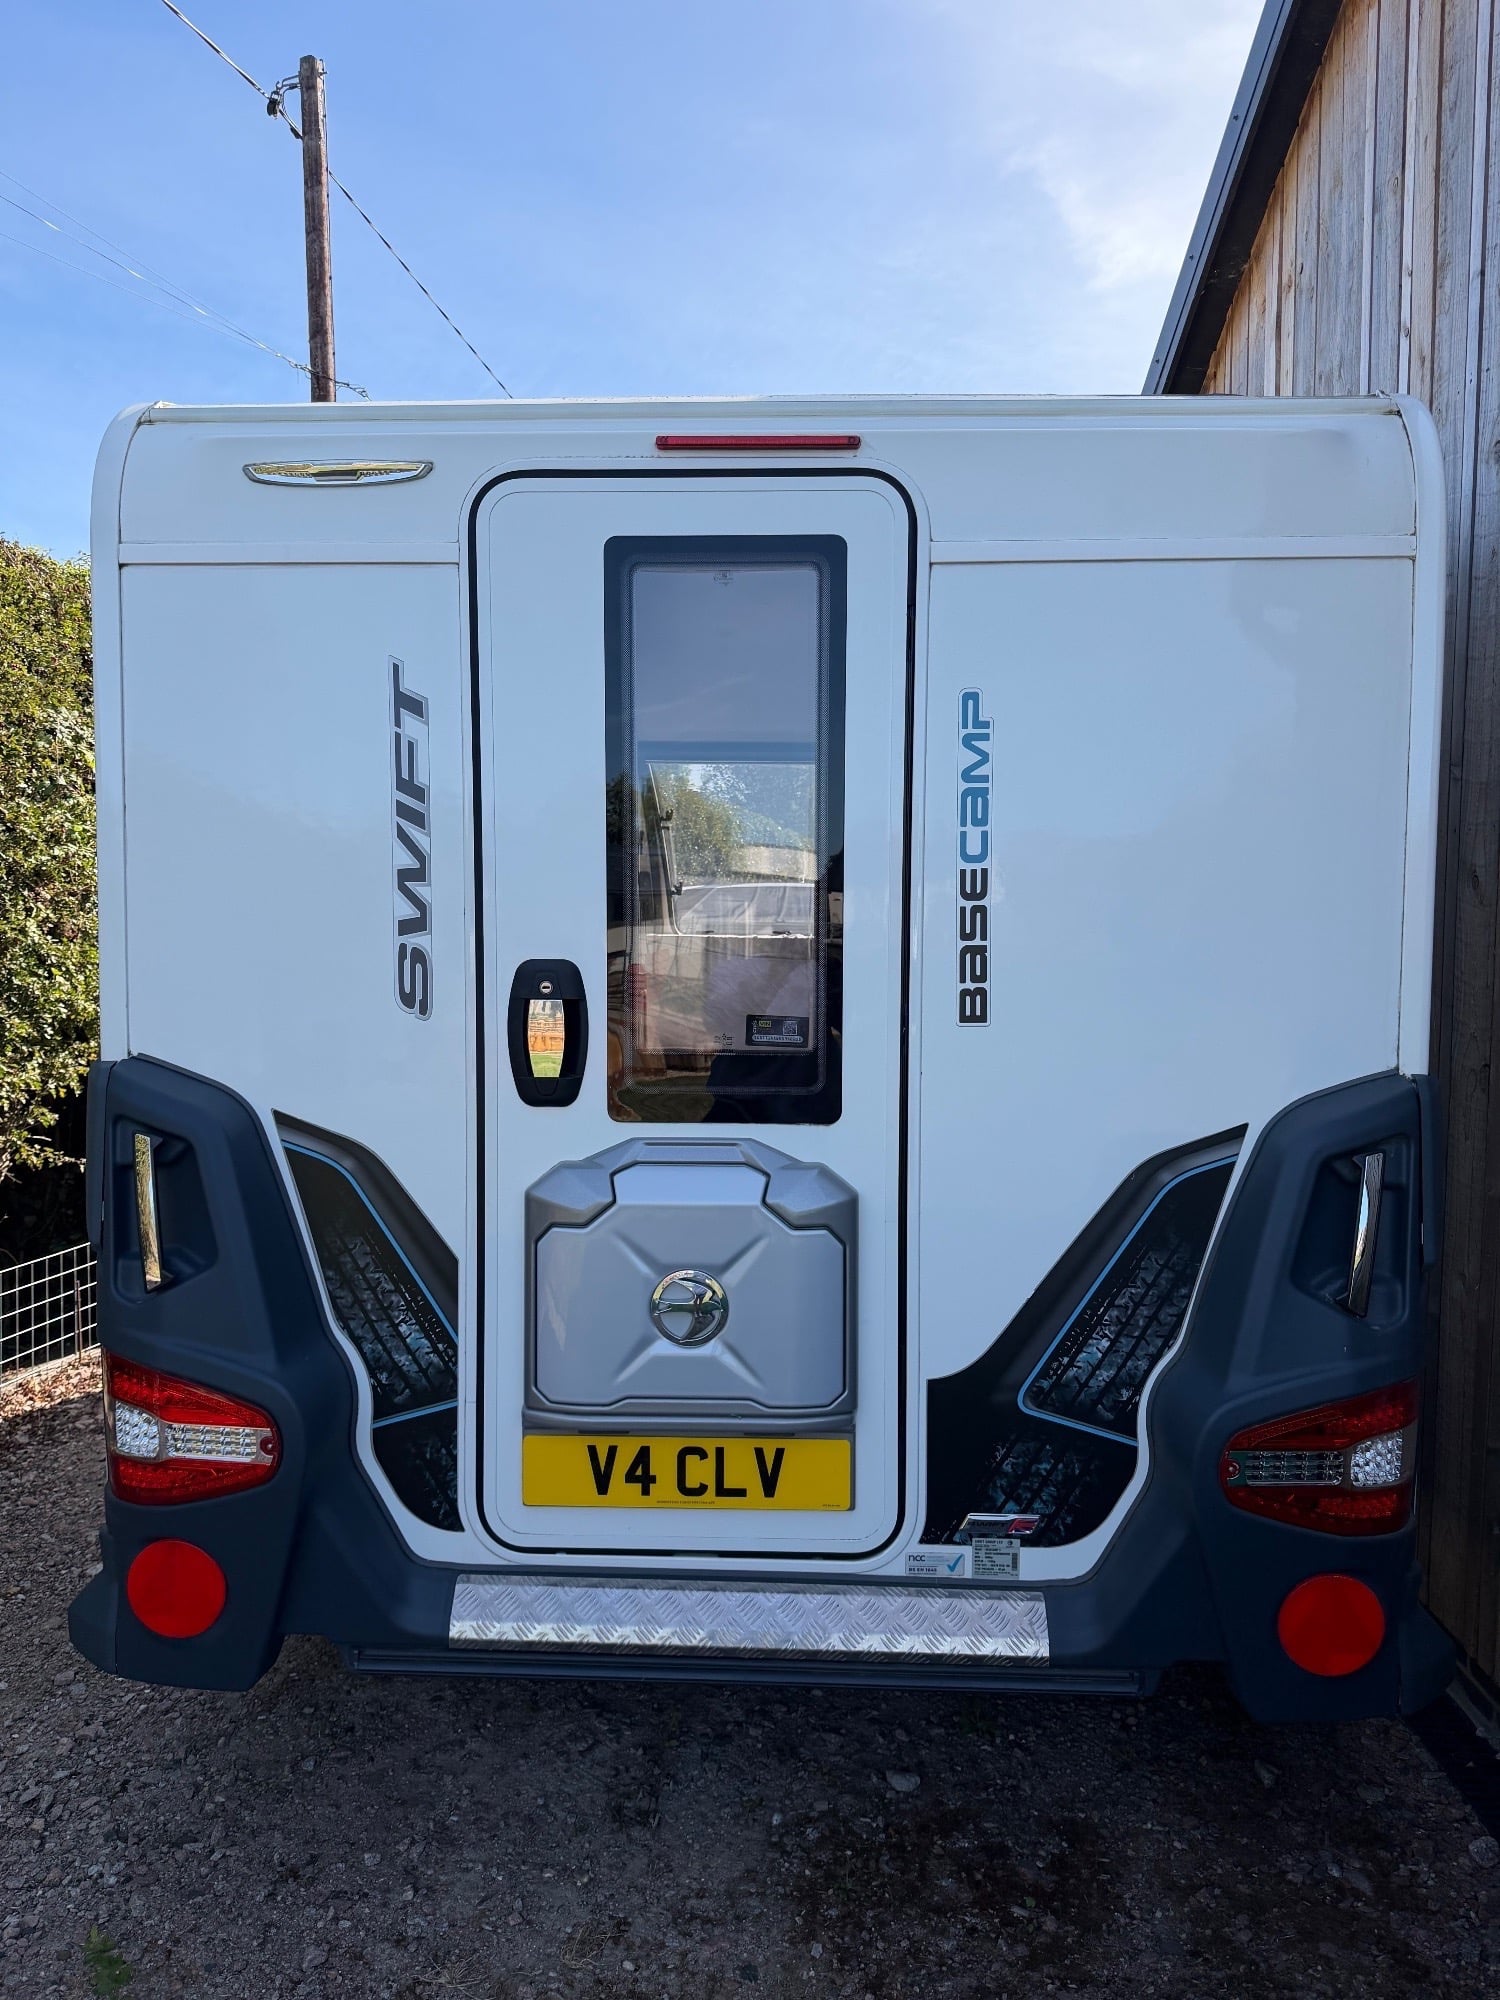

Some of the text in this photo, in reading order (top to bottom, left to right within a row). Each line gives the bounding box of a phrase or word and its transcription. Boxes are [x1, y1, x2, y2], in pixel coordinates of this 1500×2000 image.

[390, 656, 431, 1019] SWIFT
[587, 1444, 786, 1498] V4 CLV
